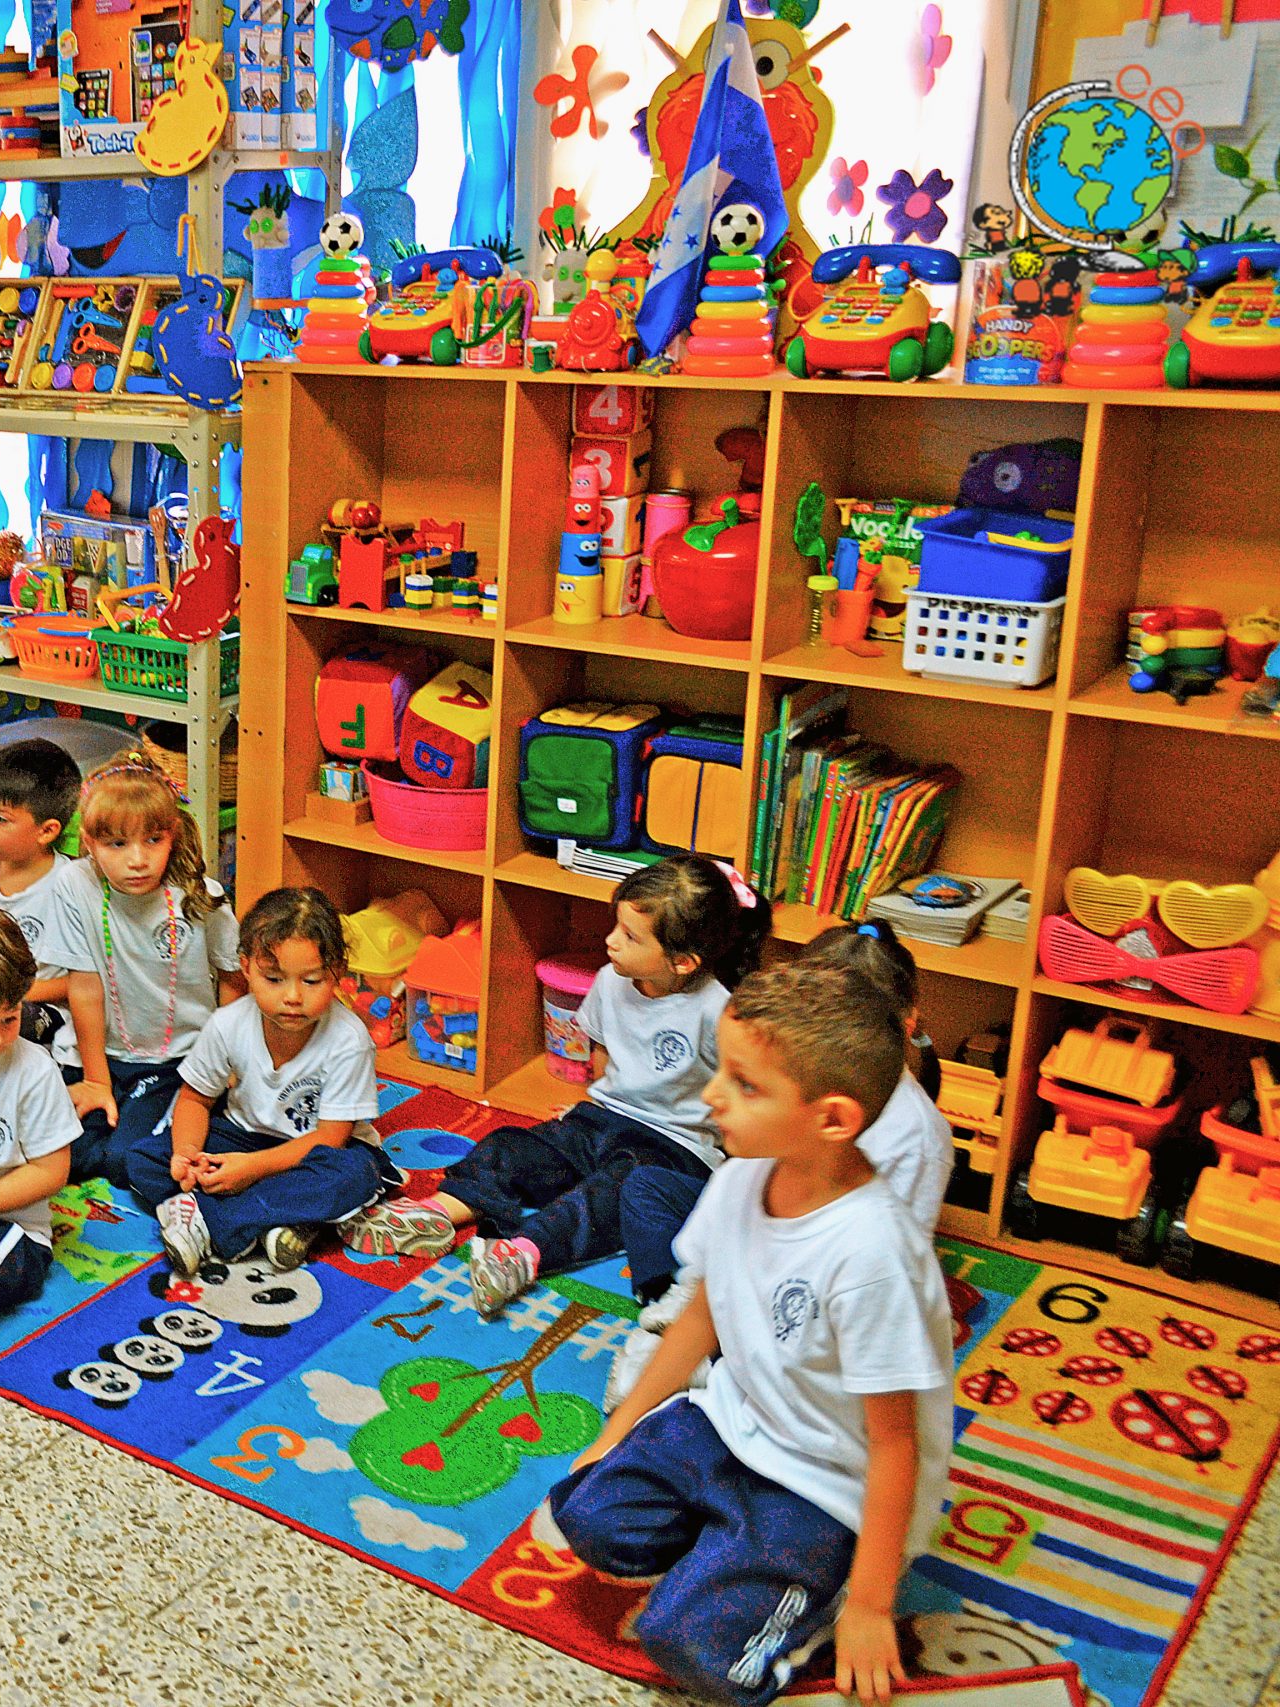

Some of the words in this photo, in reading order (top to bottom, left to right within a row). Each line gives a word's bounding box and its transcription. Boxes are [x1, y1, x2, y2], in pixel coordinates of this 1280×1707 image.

[985, 317, 1034, 334] HANDY
[589, 384, 623, 426] 4
[584, 449, 613, 490] 3
[438, 679, 489, 710] A
[340, 703, 365, 749] F
[413, 740, 455, 779] B
[195, 1350, 265, 1397] 4
[209, 1424, 307, 1485] 3
[939, 1499, 1029, 1567] 5
